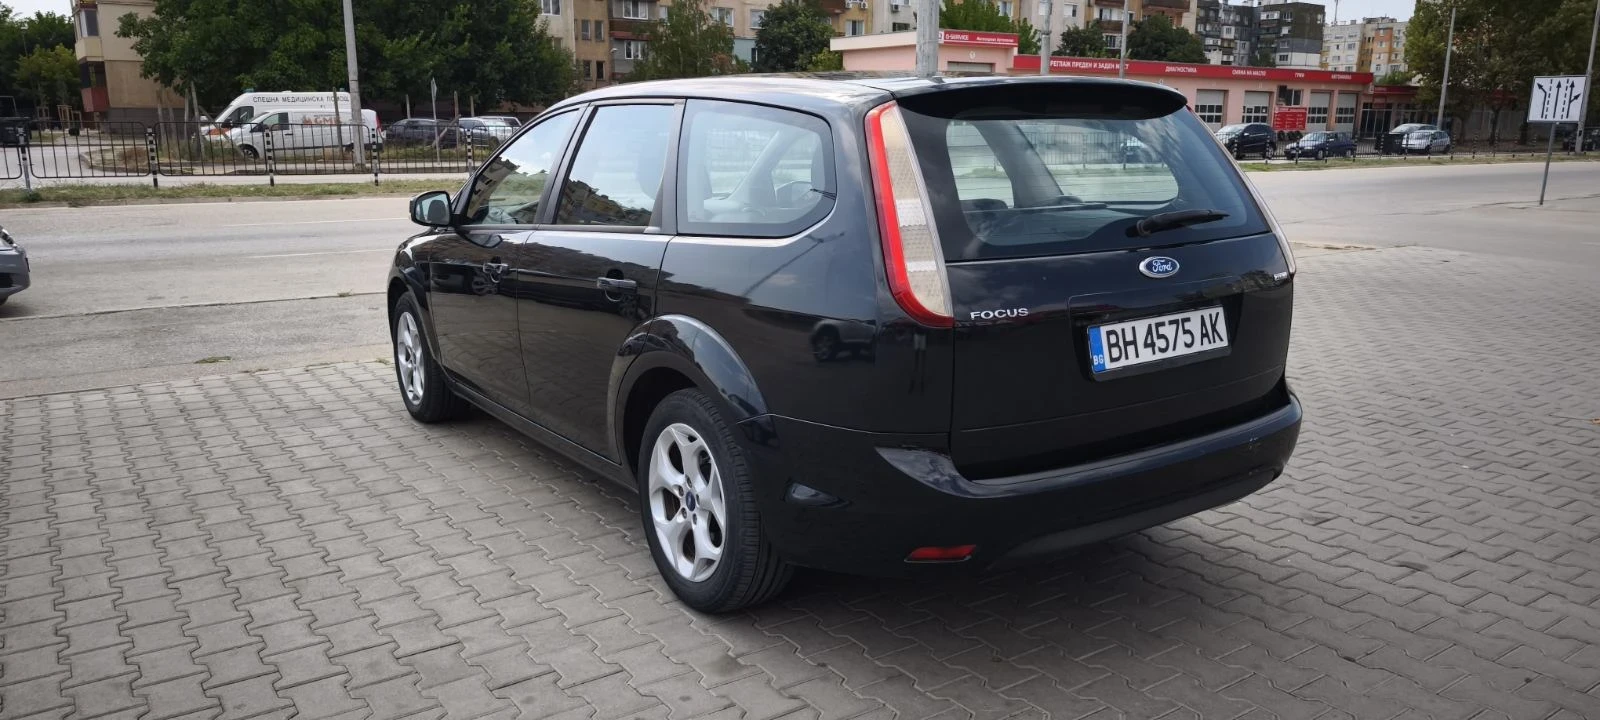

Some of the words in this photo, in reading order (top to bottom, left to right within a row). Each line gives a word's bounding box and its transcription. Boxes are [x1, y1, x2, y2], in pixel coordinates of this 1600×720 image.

[1152, 259, 1173, 272] Ford
[970, 307, 1029, 320] FOCUS
[1105, 325, 1140, 364] BH
[1143, 316, 1196, 356] 4575
[1200, 311, 1224, 346] AK
[1093, 354, 1104, 365] BG
